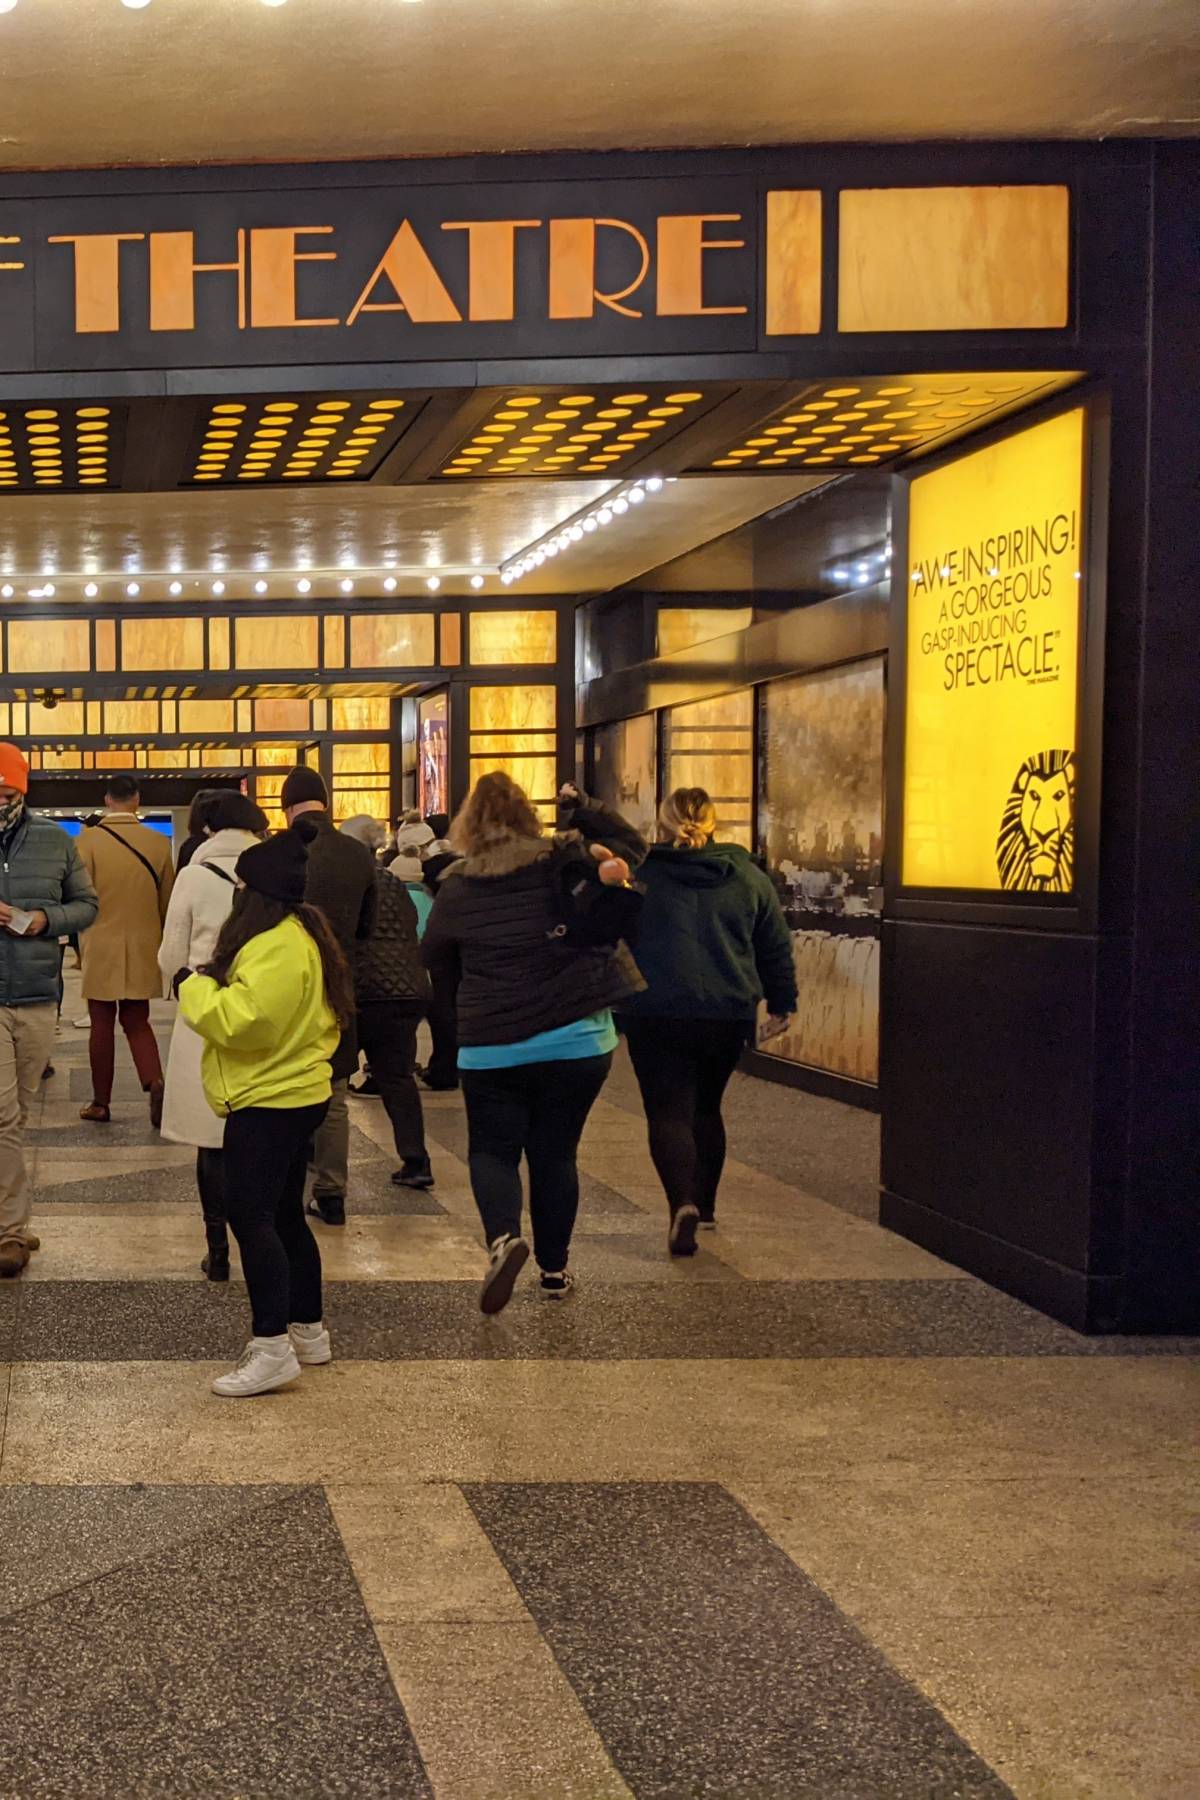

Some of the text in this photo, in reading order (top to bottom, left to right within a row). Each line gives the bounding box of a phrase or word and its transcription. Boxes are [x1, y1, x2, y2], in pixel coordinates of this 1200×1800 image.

[48, 216, 747, 333] THEATRE
[939, 565, 1052, 624] A GORGEOUS
[921, 609, 1027, 655] GASP-INDUCING
